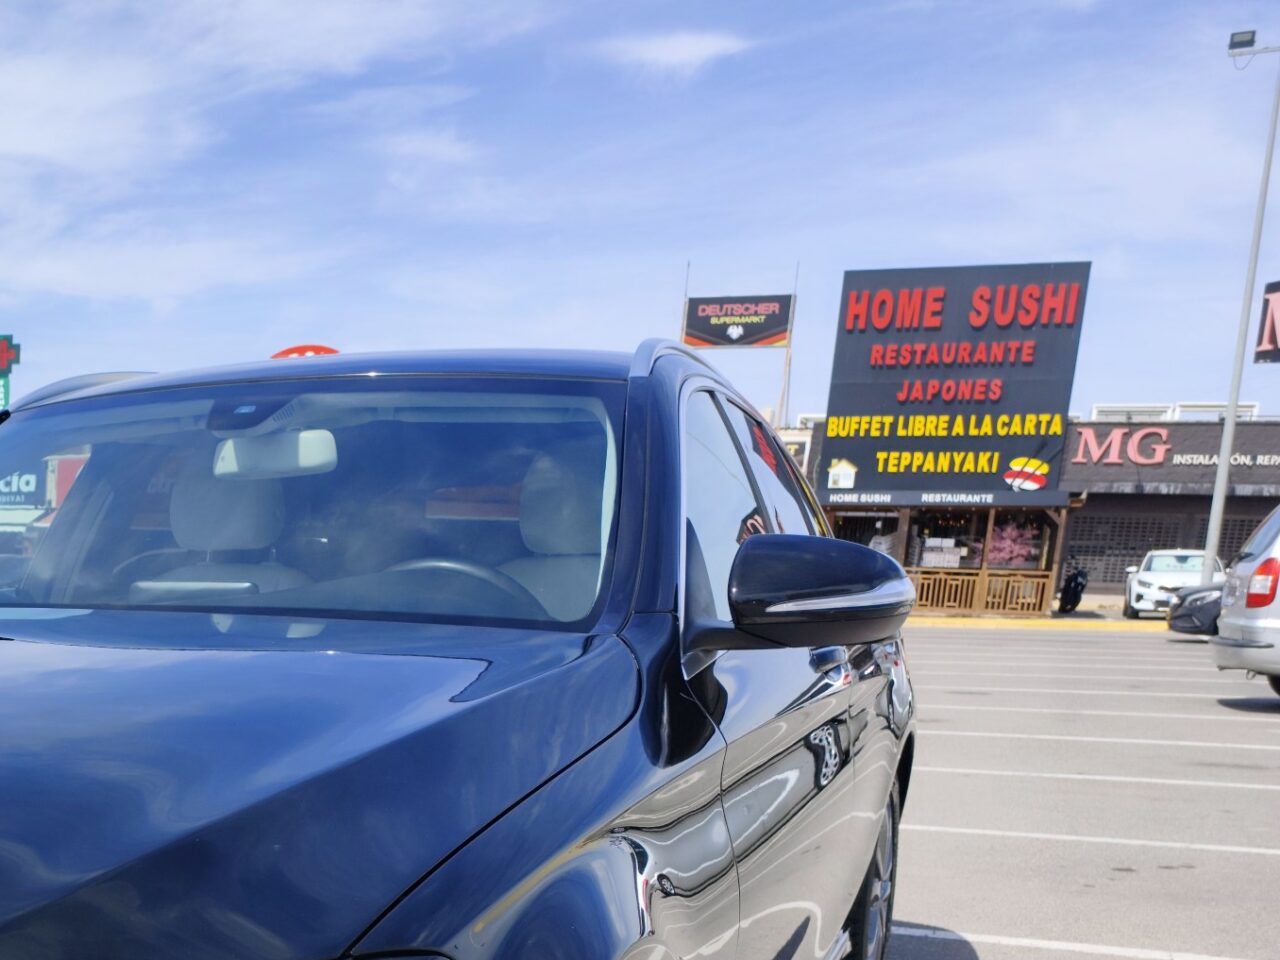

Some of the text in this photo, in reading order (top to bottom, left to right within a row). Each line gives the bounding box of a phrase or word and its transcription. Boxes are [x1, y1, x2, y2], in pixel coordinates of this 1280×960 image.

[697, 302, 780, 316] DEUTSCHER
[845, 282, 1081, 331] HOME SUSHI
[710, 315, 766, 325] SUPERMARKT
[870, 340, 1036, 366] RESTAURANTE
[896, 378, 1003, 402] JAPONES
[826, 413, 1063, 438] BUFFET LIBRE A LA CARTA
[1071, 427, 1172, 465] MG
[1172, 452, 1253, 466] INSTALAÓN,
[876, 451, 1000, 474] TEPPANYAKI
[829, 493, 891, 503] HOME SUSHI
[921, 493, 994, 504] RESTAURANTE
